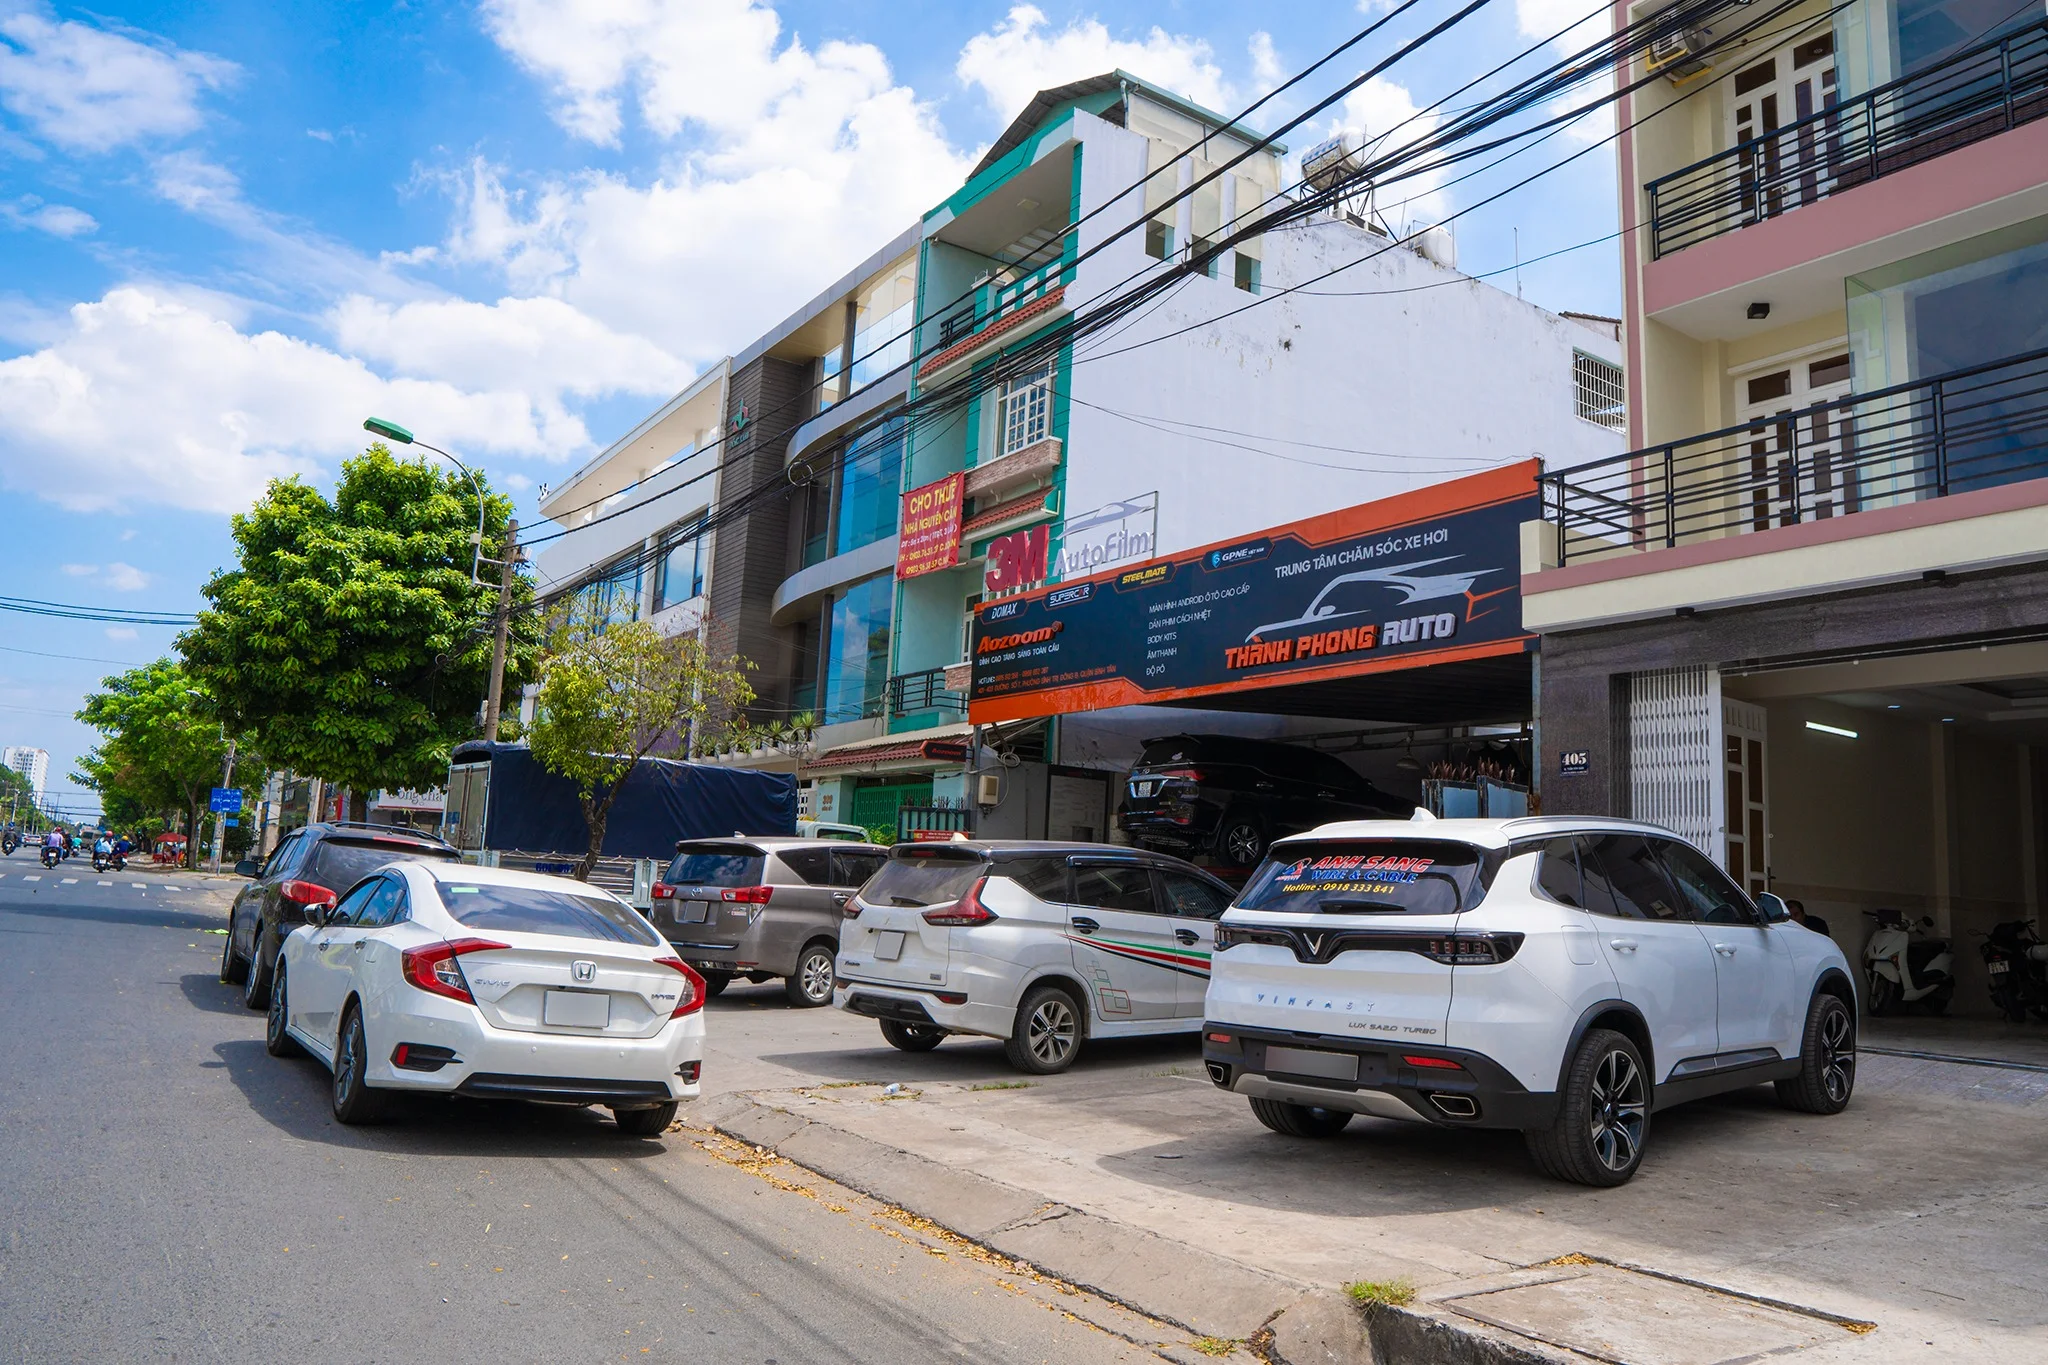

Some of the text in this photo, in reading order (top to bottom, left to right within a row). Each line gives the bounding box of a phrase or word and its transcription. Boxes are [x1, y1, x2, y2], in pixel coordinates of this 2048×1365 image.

[910, 478, 957, 514] CHO THUÊ
[904, 506, 958, 536] NHÀ NGUYÊN CĂN
[985, 524, 1050, 592] 3M
[1052, 529, 1150, 576] AutoFilm
[1222, 548, 1248, 561] GPNE
[1274, 528, 1448, 578] TRUNG TÂM CHĂM SÓC XE HƠI
[1122, 566, 1167, 584] STEELMATE
[1050, 586, 1090, 604] SUPERCAR
[1148, 603, 1164, 614] MÀN
[1164, 600, 1177, 610] HÌNH
[1178, 595, 1204, 607] ANDROID
[1221, 588, 1235, 598] CAO
[1236, 581, 1250, 595] CẤP
[991, 602, 1018, 620] DOMAX
[1148, 608, 1211, 630] DÁN PHIM CÁCH NHIỆT
[1147, 632, 1177, 644] BODY KITS
[1225, 613, 1457, 669] THÀNH PHONG AUTO
[1017, 649, 1031, 658] SÁNG
[1033, 646, 1047, 655] TOÀN
[1048, 643, 1060, 653] CẦU
[1146, 664, 1165, 677] ĐỘ PÔ
[1562, 753, 1586, 765] 405
[1311, 856, 1435, 873] ANH SANG
[1311, 869, 1348, 880] WIRE
[1349, 870, 1361, 880] &
[1363, 870, 1418, 885] CABLE
[1282, 883, 1316, 892] Hotline
[1323, 883, 1350, 891] 0918
[1351, 884, 1372, 893] 333
[1373, 885, 1395, 894] 841
[1258, 993, 1375, 1012] VINFAST
[1403, 1026, 1437, 1035] TURBO
